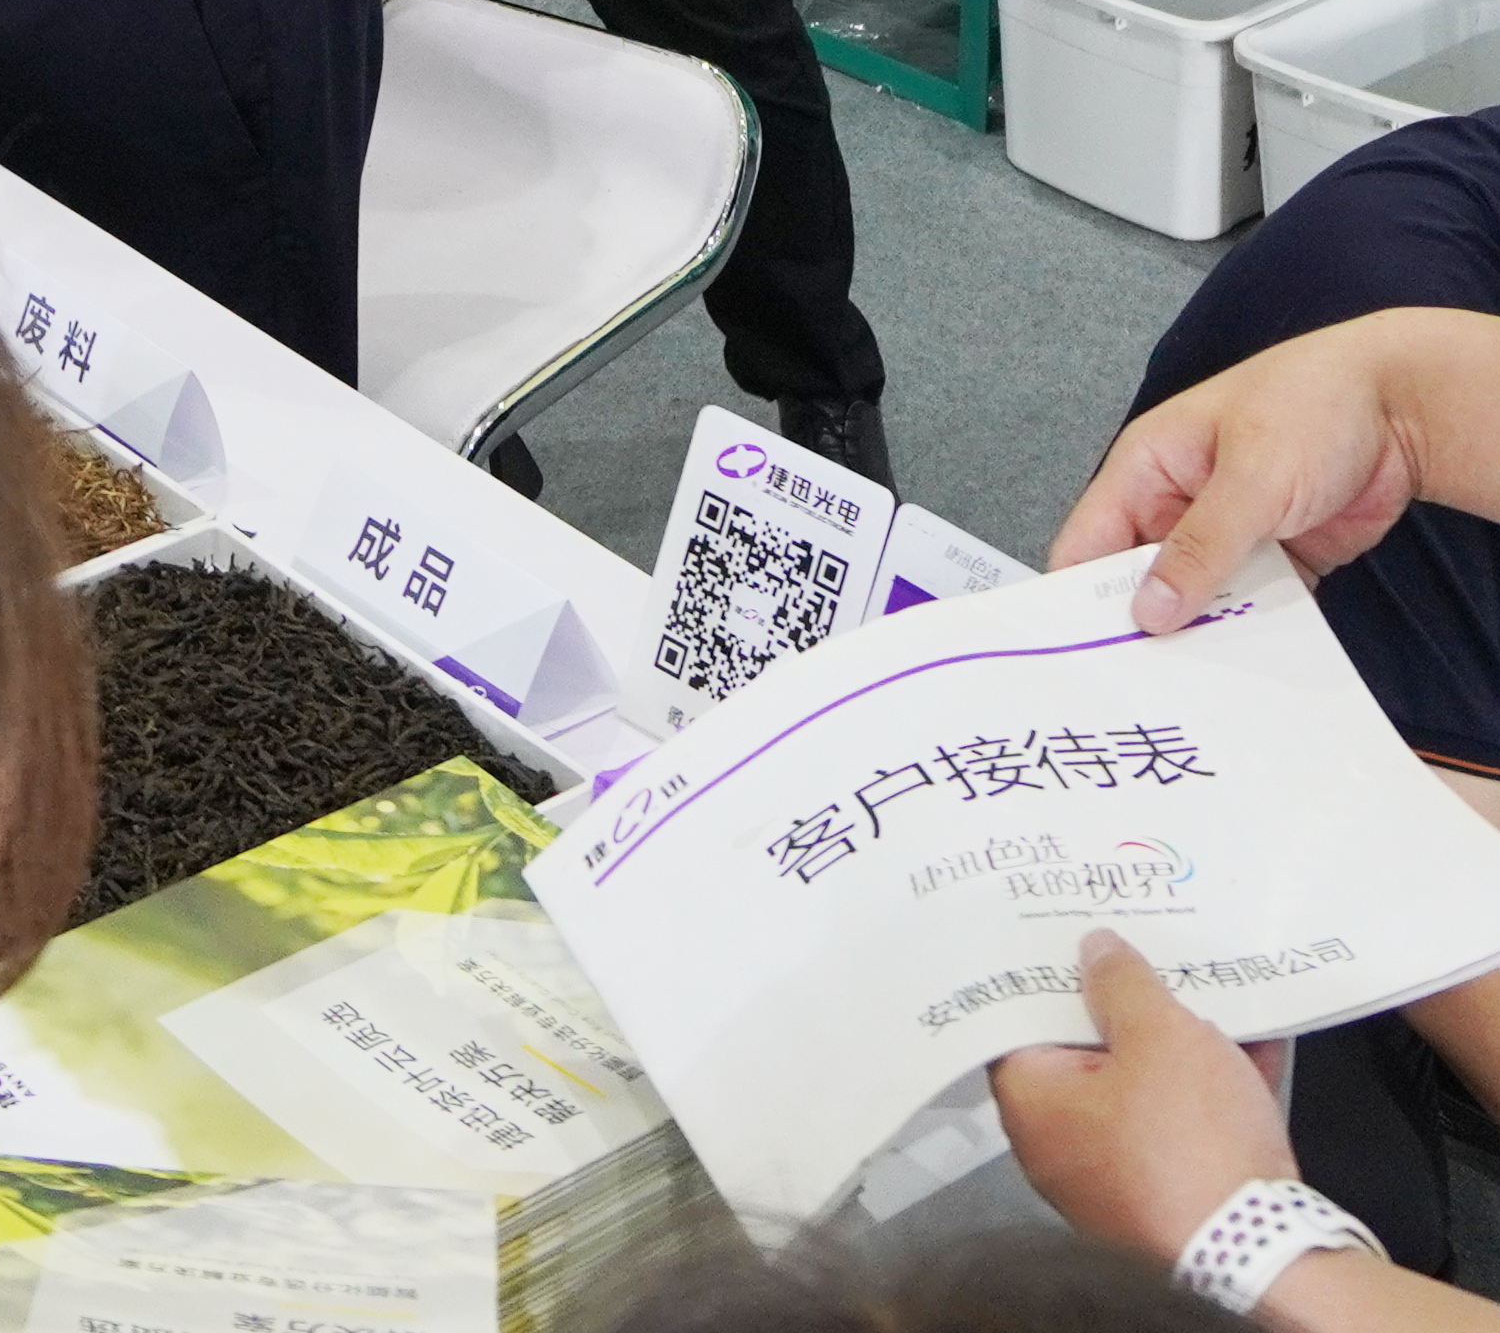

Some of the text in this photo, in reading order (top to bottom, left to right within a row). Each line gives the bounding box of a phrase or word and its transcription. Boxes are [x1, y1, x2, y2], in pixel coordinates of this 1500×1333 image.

[13, 291, 101, 384] 废料
[765, 462, 862, 530] 捷迅光电
[348, 513, 459, 620] 成品
[766, 722, 1216, 886] 客户接待表
[1005, 861, 1176, 906] 我的视界
[321, 1000, 536, 1153] 捷迅茶叶云质选
[448, 1038, 585, 1127] 解决方案
